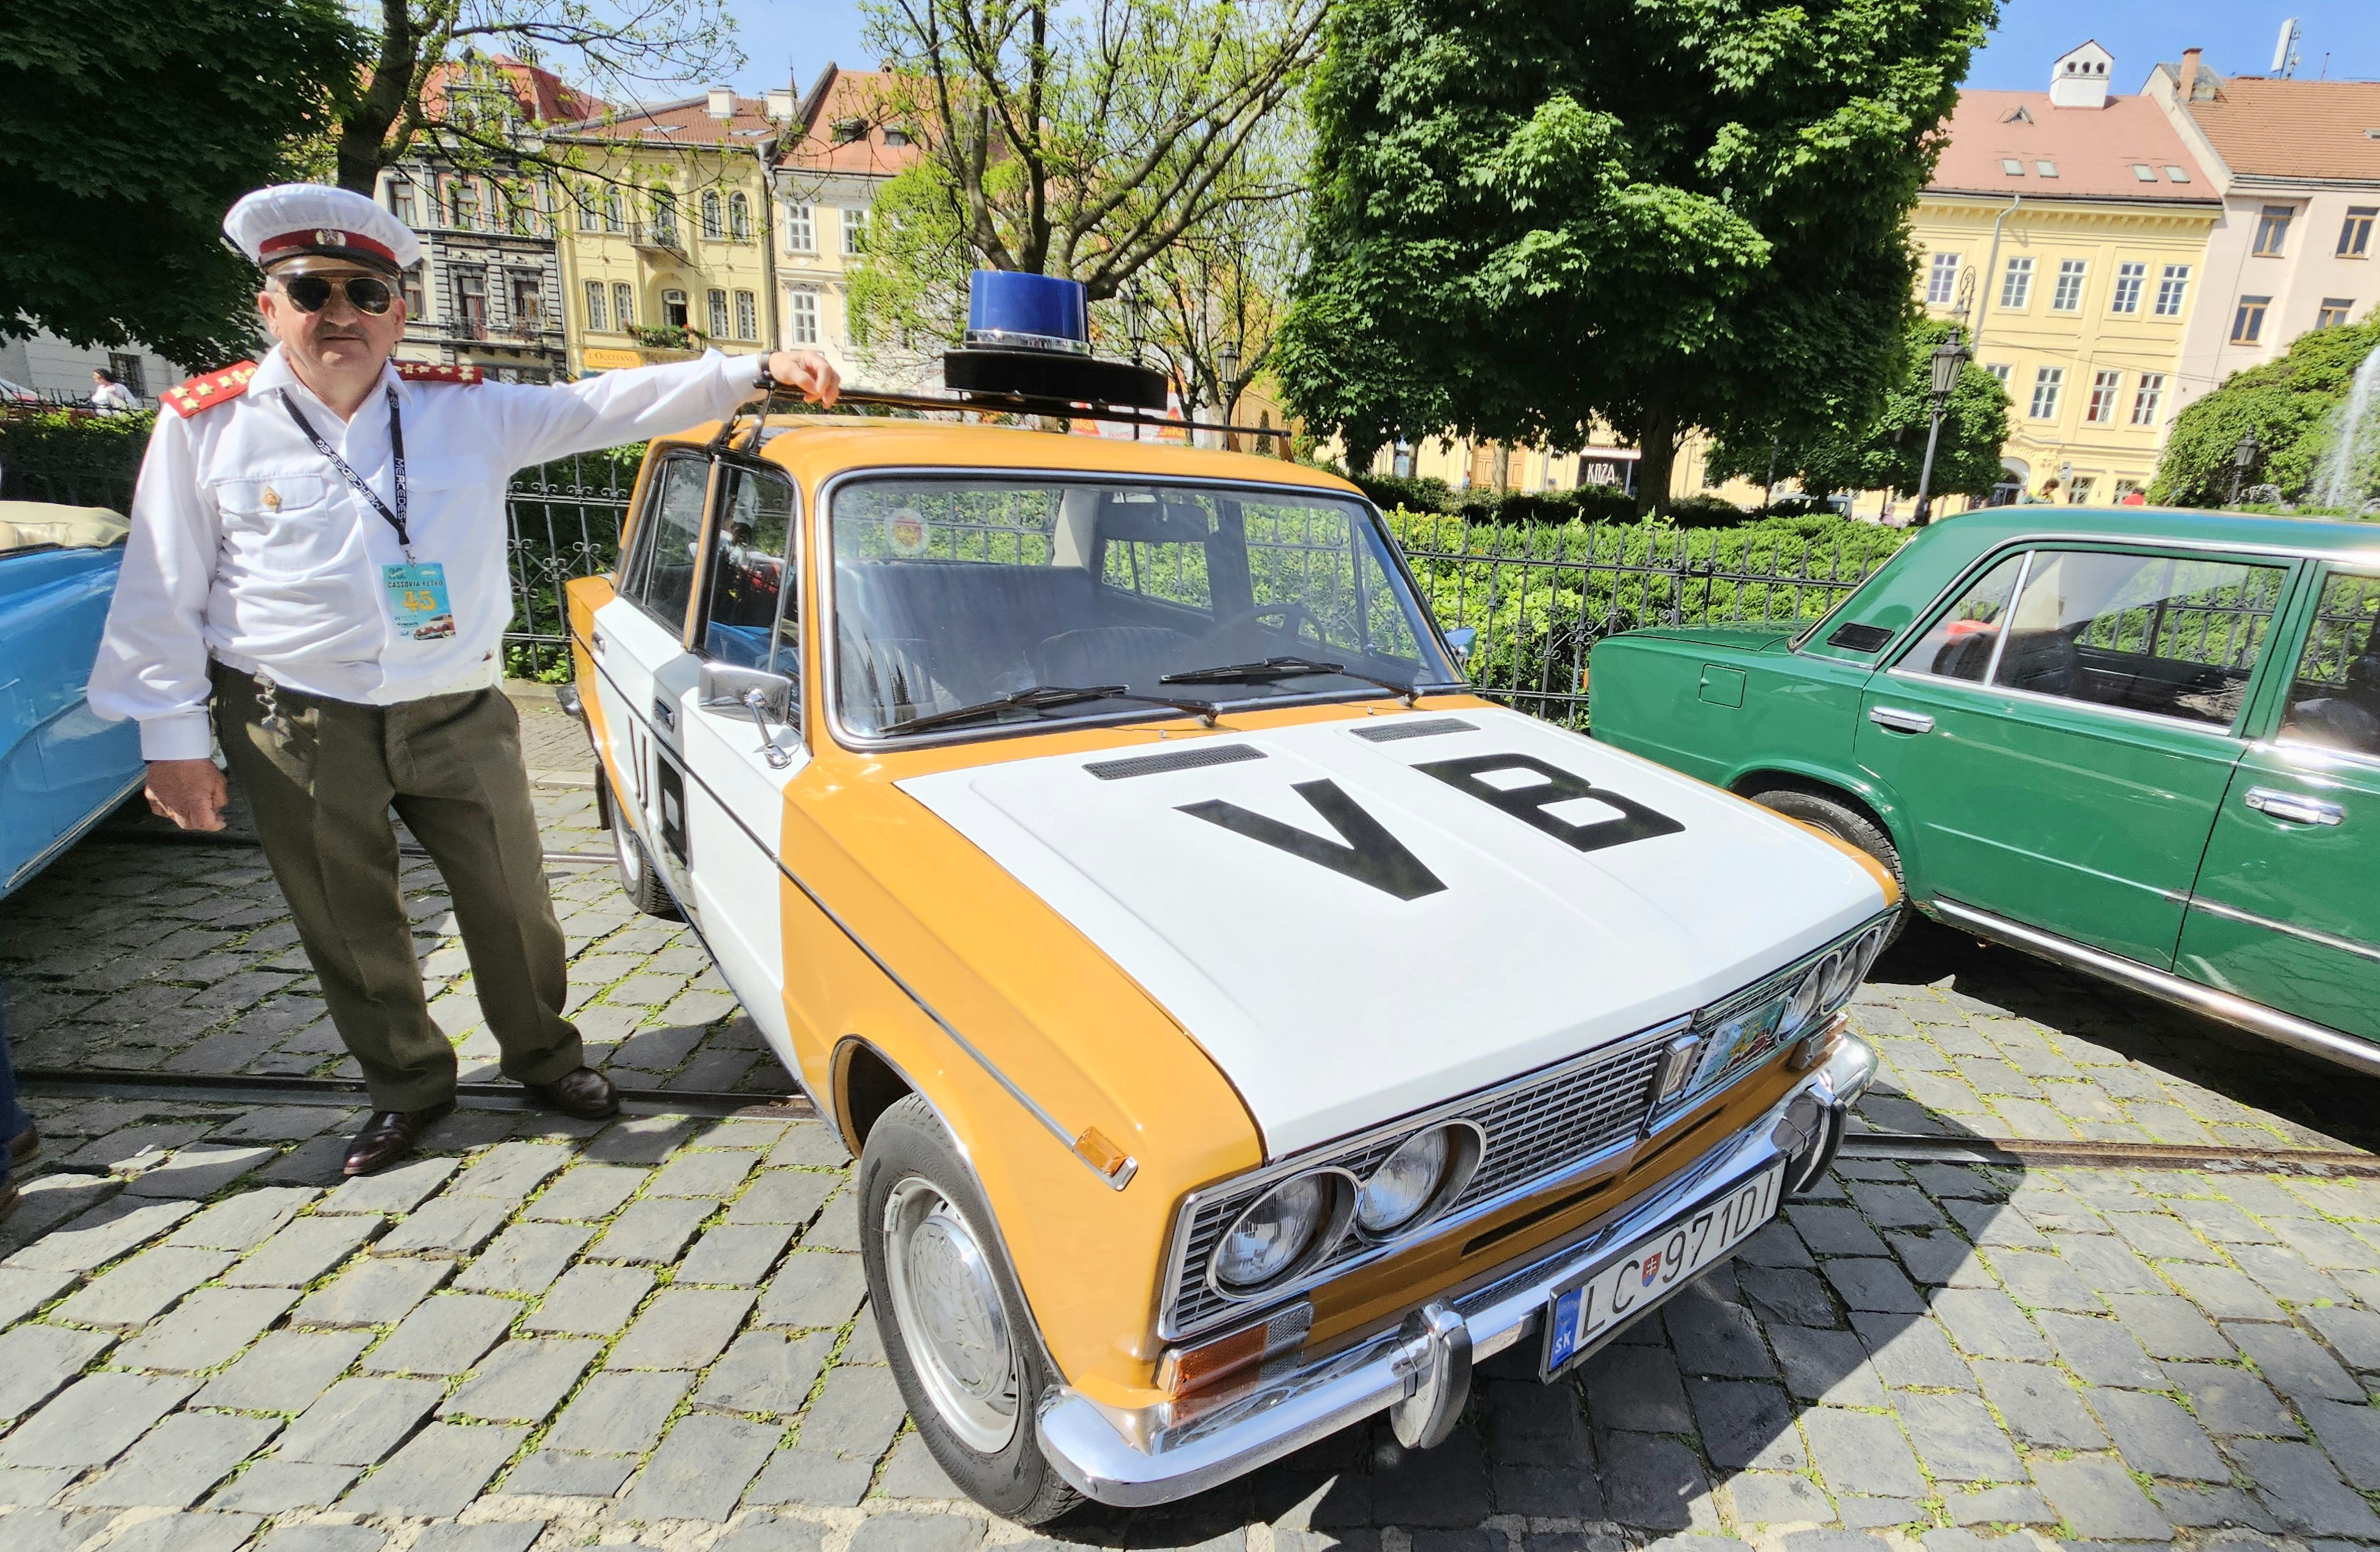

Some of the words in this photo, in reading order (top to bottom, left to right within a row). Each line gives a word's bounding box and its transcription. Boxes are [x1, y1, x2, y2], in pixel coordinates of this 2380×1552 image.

[388, 580, 420, 589] CASSOVIA
[402, 589, 436, 612] 45
[1582, 1260, 1640, 1339] LC
[1663, 1171, 1775, 1284] 971DI
[1555, 1331, 1572, 1354] SK
